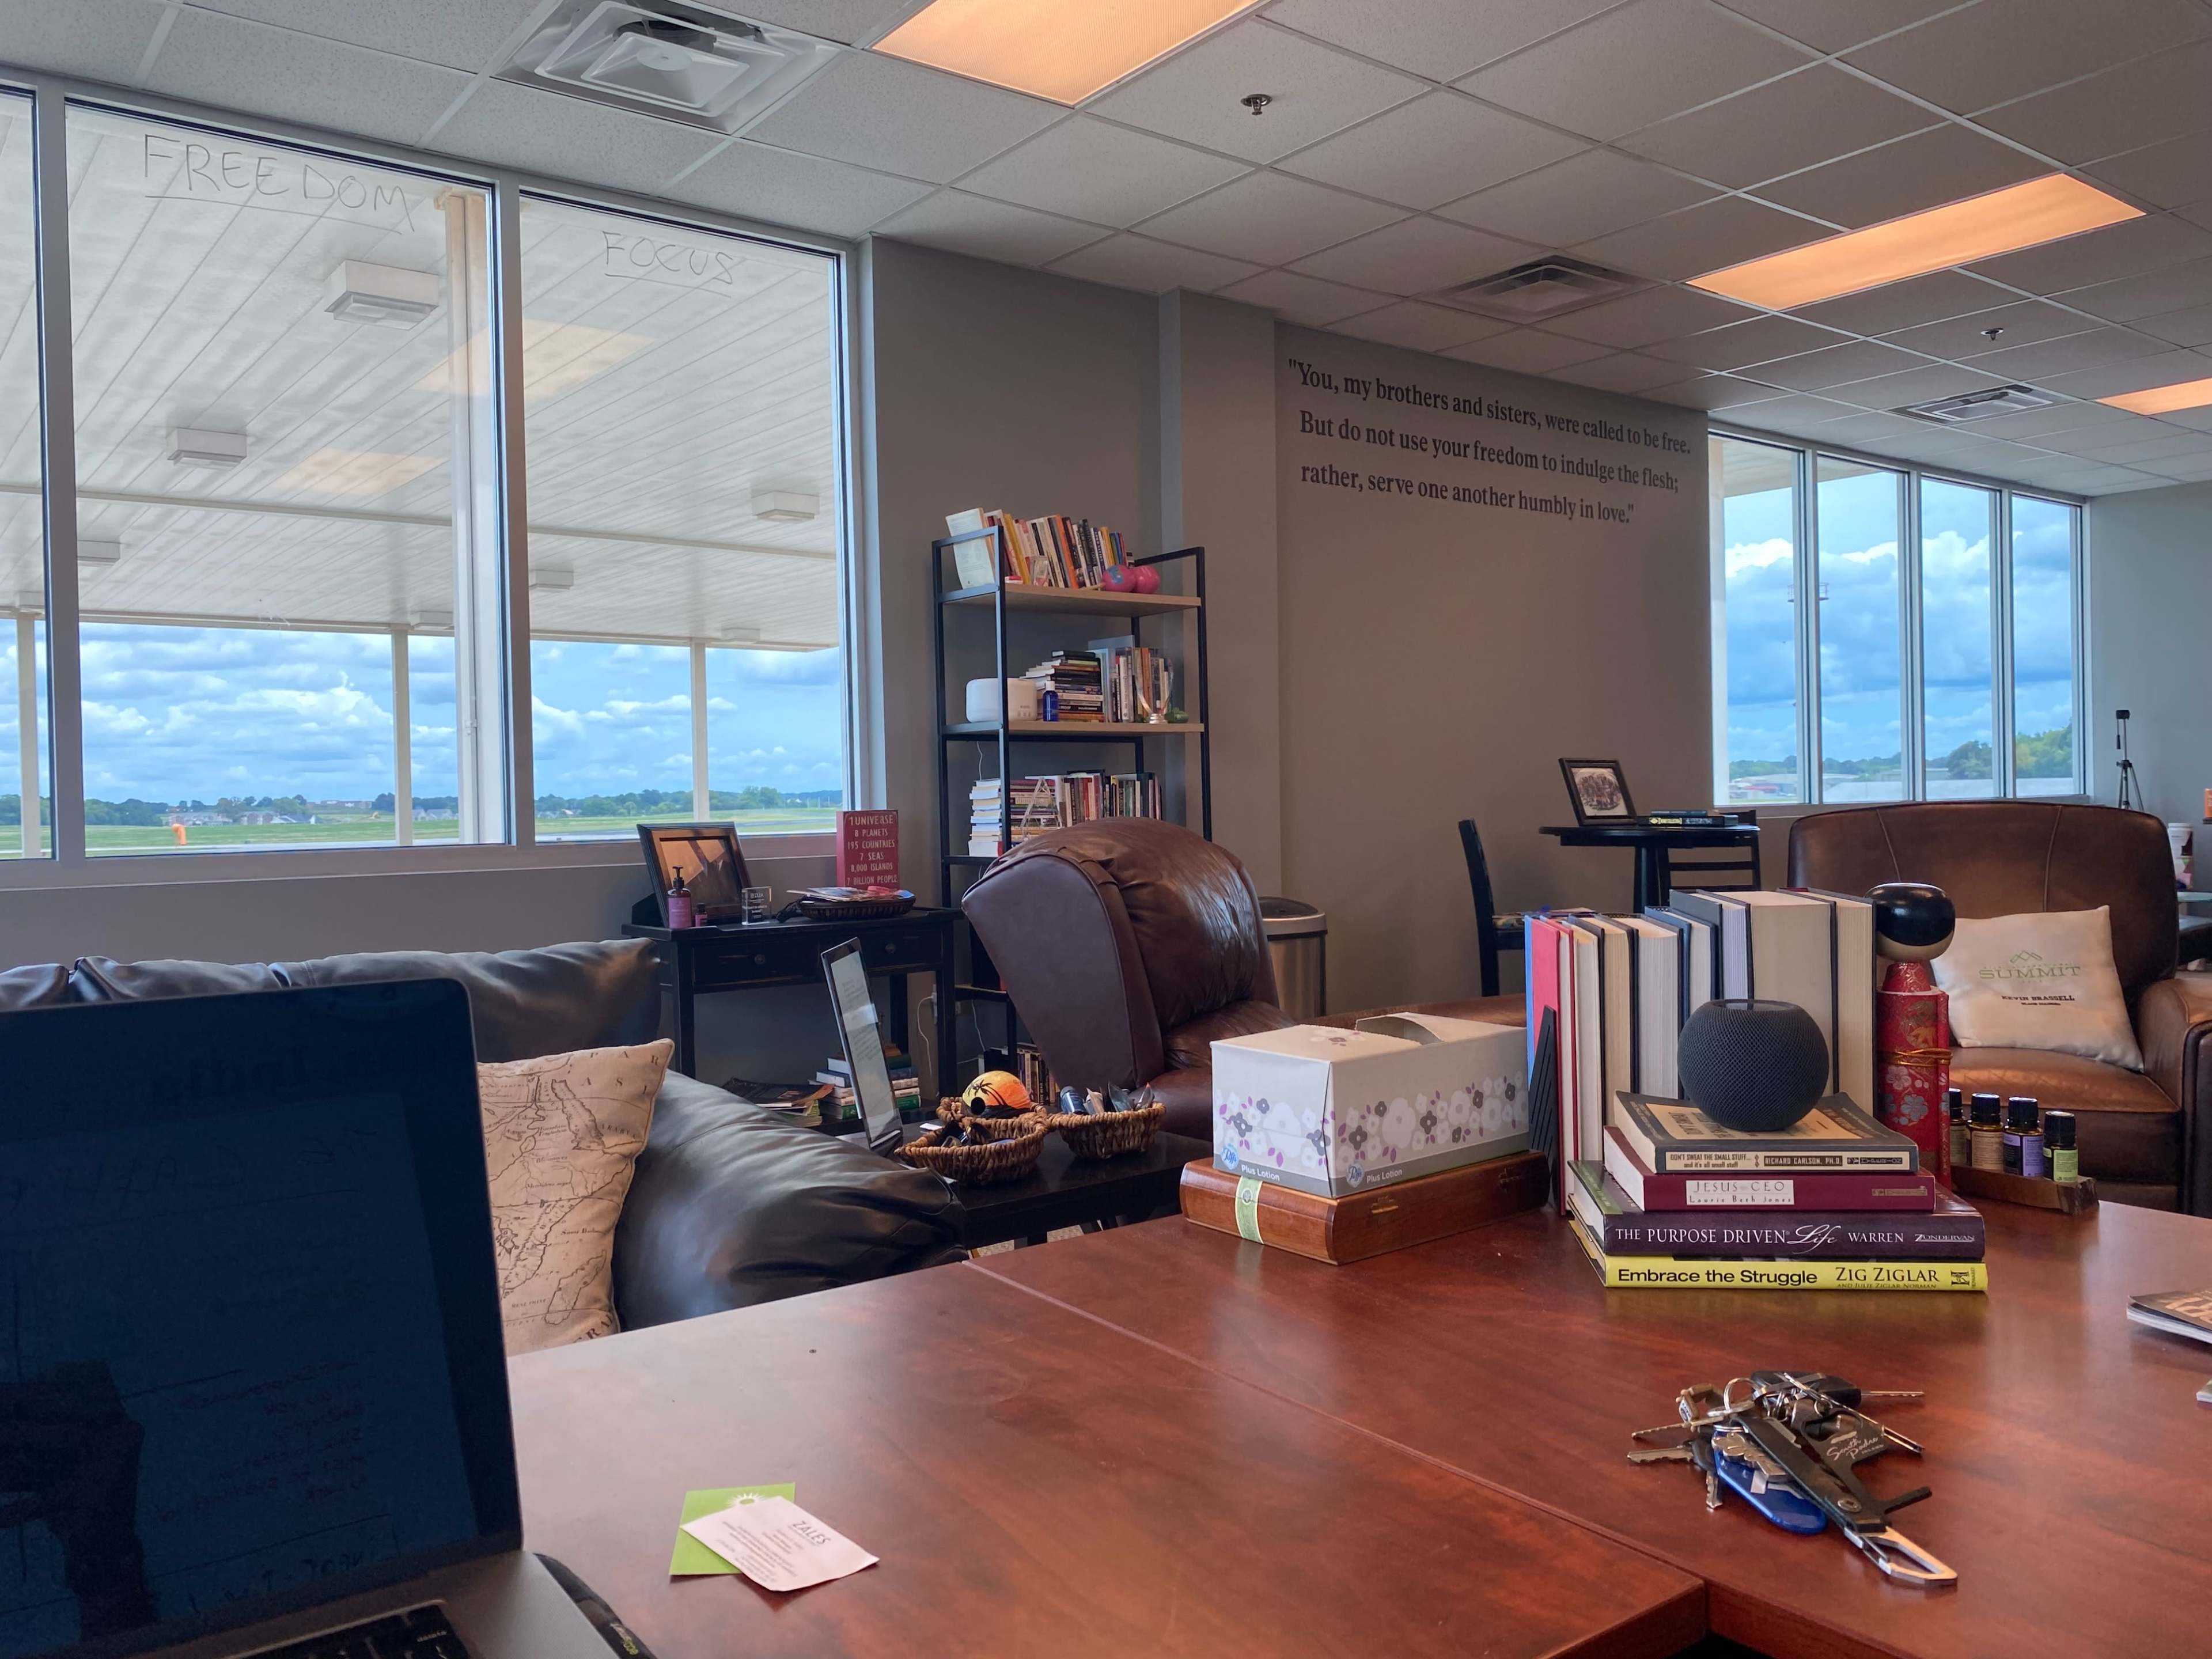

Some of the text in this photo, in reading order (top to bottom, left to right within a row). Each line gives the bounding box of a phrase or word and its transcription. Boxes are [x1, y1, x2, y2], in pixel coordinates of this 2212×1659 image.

[145, 134, 415, 232] FREEDOM
[602, 230, 733, 285] FOCUS
[1289, 358, 1691, 454] "You, my brothers and sisters, were called to be free.
[1300, 410, 1679, 494] But do not use your freedom to indulge the flesh;
[1301, 463, 1634, 523] rather, serve one another humbly in love."
[849, 815, 893, 825] 1 UNIVERSE
[862, 828, 888, 837] PLANETS
[847, 839, 895, 850] 195 COUNTRIES
[859, 851, 884, 861] 7 SEAS
[851, 862, 893, 873] 8,000 ISLANDS
[846, 874, 897, 885] 7 BILLION PEOPLE
[1979, 966, 2081, 979] SUMMIT
[1241, 1164, 1280, 1181] Plus Lotion
[1366, 1169, 1403, 1184] Plus Lotion
[1693, 1181, 1785, 1193] JESUS CEO
[1615, 1224, 1842, 1255] THE PURPOSE DRIVEN Life
[1848, 1232, 1904, 1243] WARREN
[1914, 1233, 1975, 1242] ZONDERVAN
[1618, 1268, 1817, 1286] Embrace the Struggle
[1835, 1267, 1940, 1282] ZIG ZIGLAR
[792, 1520, 831, 1546] ZALES
